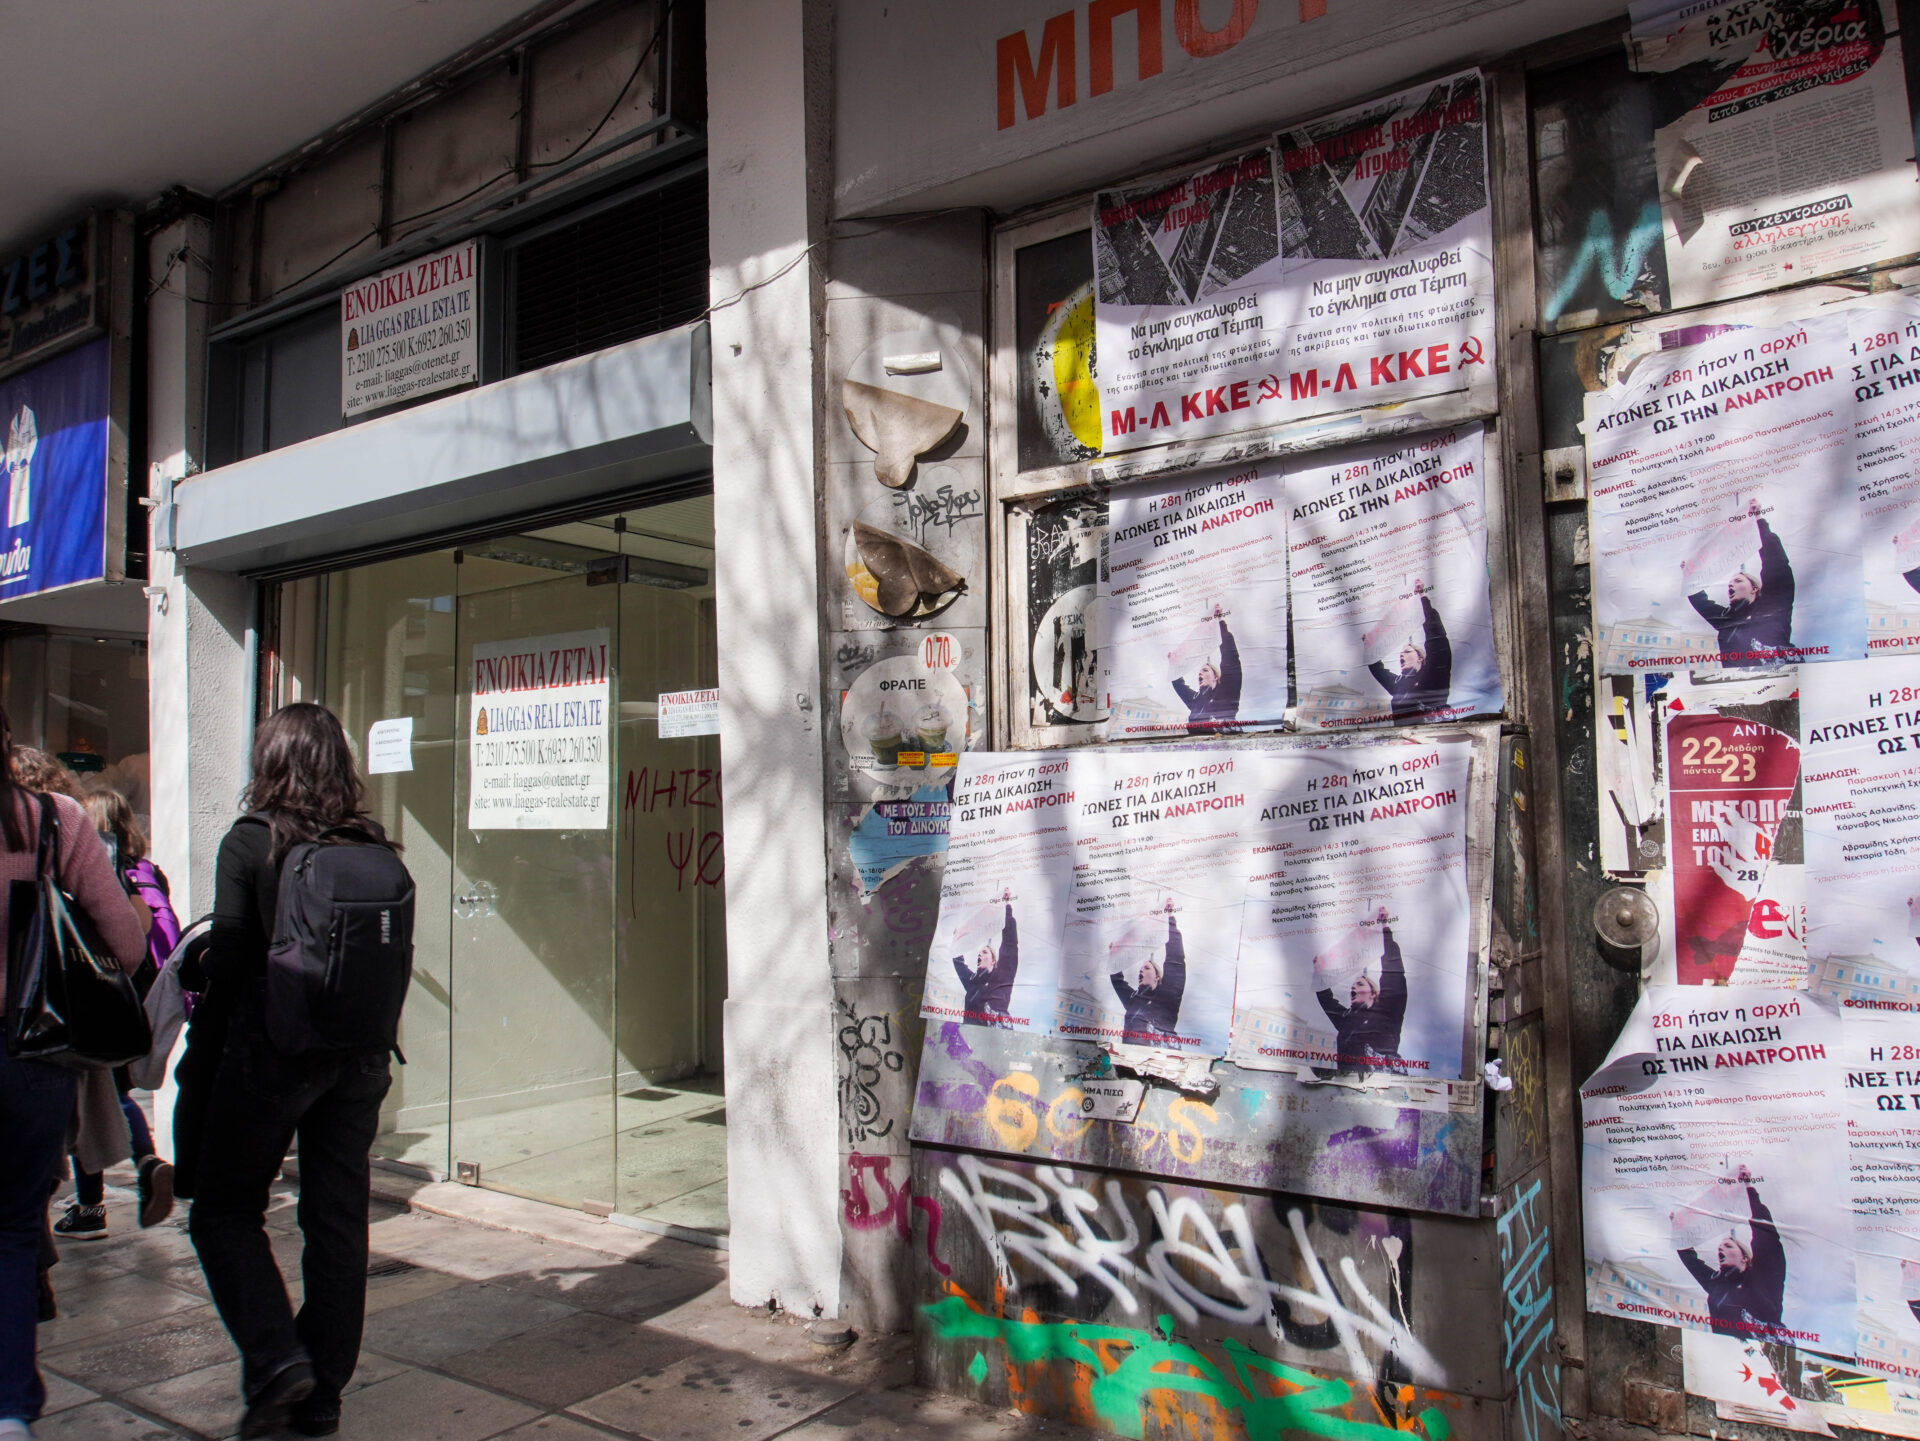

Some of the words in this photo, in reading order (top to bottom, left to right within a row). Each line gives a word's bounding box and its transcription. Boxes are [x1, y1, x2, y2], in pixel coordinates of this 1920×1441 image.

[1777, 18, 1868, 59] χέρια
[996, 0, 1328, 132] ΜΠΟ
[1710, 104, 1740, 122] από
[1745, 95, 1767, 108] τις
[1774, 59, 1868, 98] καταλήψεις
[1731, 196, 1849, 235] συγκέντρωση
[1733, 213, 1850, 250] αλληλεγγύης
[1703, 260, 1721, 270] δευ.
[1746, 250, 1767, 261] 9:00
[1771, 235, 1824, 253] δικαστήρια
[1827, 221, 1876, 238] θεσ/νίκης
[345, 246, 473, 321] ΕΝΟΙΚΙΑΖΕΤΑΙ
[1309, 305, 1324, 318] το
[1327, 291, 1387, 316] έγκλημα
[1390, 284, 1417, 299] στα
[1420, 271, 1467, 294] Τέμπη
[1313, 281, 1332, 297] Να
[1337, 275, 1361, 294] μην
[1365, 247, 1461, 286] συγκαλυφθεί
[360, 312, 401, 346] LIAGGAS
[404, 305, 430, 331] REAL
[432, 290, 470, 322] ESTATE
[1128, 348, 1140, 361] το
[1142, 334, 1193, 358] έγκλημα
[1197, 327, 1219, 342] στα
[1222, 314, 1263, 336] Τέμπη
[1131, 325, 1146, 340] Να
[1150, 319, 1172, 338] μην
[1174, 293, 1258, 329] συγκαλυφθεί
[1297, 328, 1332, 342] Ενάντια
[1336, 322, 1357, 334] στην
[1361, 313, 1404, 328] πολιτική
[1408, 310, 1424, 320] της
[1428, 297, 1475, 316] φτώχειας
[1304, 337, 1350, 353] ακρίβειας
[1354, 334, 1369, 342] και
[1373, 329, 1390, 338] των
[1394, 307, 1485, 334] ιδιωτικοποιήσεων
[355, 375, 383, 390] e-mail:
[385, 351, 460, 382] liaggas@otenet.gr
[1106, 385, 1120, 394] της
[1124, 377, 1163, 392] ακρίβειας
[1167, 372, 1180, 381] και
[1183, 368, 1198, 378] των
[1201, 347, 1281, 373] ιδιωτικοποιήσεων
[1117, 370, 1147, 382] Ενάντια
[1151, 362, 1169, 375] στην
[1173, 354, 1209, 369] πολιτική
[1212, 349, 1226, 359] της
[1230, 338, 1272, 356] φτώχειας
[1290, 363, 1357, 401] Μ-Λ
[1370, 343, 1450, 386] ΚΚΕ
[1699, 352, 1738, 378] ήταν
[1744, 349, 1754, 362] η
[1760, 328, 1807, 354] αρχή
[346, 395, 363, 409] site:
[366, 362, 471, 403] www.liaggas-realestate.gr
[1111, 401, 1171, 436] Μ-Λ
[1181, 380, 1250, 422] ΚΚΕ
[1596, 399, 1663, 433] ΑΓΩΝΕΣ
[1667, 390, 1695, 409] ΓΙΑ
[1701, 358, 1790, 399] ΔΙΚΑΙΩΣΗ
[1653, 415, 1679, 434] ΩΣ
[1681, 402, 1719, 425] ΤΗΝ
[1724, 365, 1834, 413] ΑΝΑΤΡΟΠΗ
[1332, 473, 1340, 486] Η
[1345, 464, 1369, 482] 28η
[1373, 451, 1402, 471] ήταν
[1408, 446, 1416, 459] η
[1420, 432, 1456, 452] αρχή
[1629, 447, 1673, 466] Παρασκευή
[1675, 441, 1693, 452] 14/3
[1694, 434, 1715, 445] 19:00
[1631, 455, 1678, 475] Πολυτεχνική
[1679, 448, 1704, 461] Σχολή
[1705, 432, 1754, 453] Αμφιθέατρο
[1755, 408, 1834, 438] Παναγιωτόπουλος
[1293, 491, 1345, 521] ΑΓΩΝΕΣ
[1349, 483, 1371, 500] ΓΙΑ
[1376, 455, 1442, 491] ΔΙΚΑΙΩΣΗ
[1339, 505, 1358, 523] ΩΣ
[1360, 494, 1389, 515] ΤΗΝ
[1394, 461, 1474, 503] ΑΝΑΤΡΟΠΗ
[475, 645, 607, 695] ΕΝΟΙΚΙΑΖΕΤΑΙ
[1628, 657, 1686, 668] ΦΟΙΤΗΤΙΚΟΙ
[1689, 651, 1742, 664] ΣΥΛΛΟΓΟΙ
[1745, 646, 1829, 660] ΘΕΣΣΑΛΟΝΙΚΗΣ
[879, 678, 927, 691] ΦΡΑΠΕ
[490, 704, 532, 733] LIAGGAS
[534, 703, 561, 730] REAL
[564, 699, 602, 727] ESTATE
[1307, 778, 1317, 791] Η
[1322, 775, 1348, 789] 28η
[1353, 767, 1384, 784] ήταν
[1389, 764, 1398, 777] η
[1402, 751, 1440, 771] αρχή
[1682, 737, 1727, 765] 22
[1721, 754, 1756, 783] 23
[474, 796, 490, 809] site:
[492, 793, 600, 813] www.liaggas-realestate.gr
[484, 772, 511, 788] e-mail:
[513, 771, 590, 791] liaggas@otenet.gr
[1260, 799, 1319, 822] ΑΓΩΝΕΣ
[1324, 794, 1348, 810] ΓΙΑ
[1352, 776, 1425, 805] ΔΙΚΑΙΩΣΗ
[884, 804, 898, 817] ΜΕ
[902, 803, 924, 816] ΤΟΥΣ
[889, 822, 907, 835] ΤΟΥ
[1309, 817, 1329, 832] ΩΣ
[1333, 810, 1365, 827] ΤΗΝ
[1370, 789, 1457, 821] ΑΝΑΤΡΟΠΗ
[1737, 870, 1759, 881] 28
[1652, 1013, 1683, 1028] 28η
[1689, 1008, 1729, 1025] ήταν
[1736, 1006, 1746, 1022] η
[1752, 998, 1800, 1022] αρχή
[1642, 1060, 1667, 1076] ΩΣ
[1673, 1055, 1709, 1074] ΤΗΝ
[1714, 1043, 1827, 1069] ΑΝΑΤΡΟΠΗ
[1656, 1036, 1685, 1052] ΓΙΑ
[1691, 1025, 1782, 1049] ΔΙΚΑΙΩΣΗ
[1104, 1087, 1124, 1096] ΠΙΣΩ
[1617, 1302, 1675, 1319] ΦΟΙΤΗΤΙΚΟΙ
[1679, 1312, 1733, 1329] ΣΥΛΛΟΓΟΙ
[1736, 1322, 1820, 1343] ΘΕΣΣΑΛΟΝΙΚΗΣ
